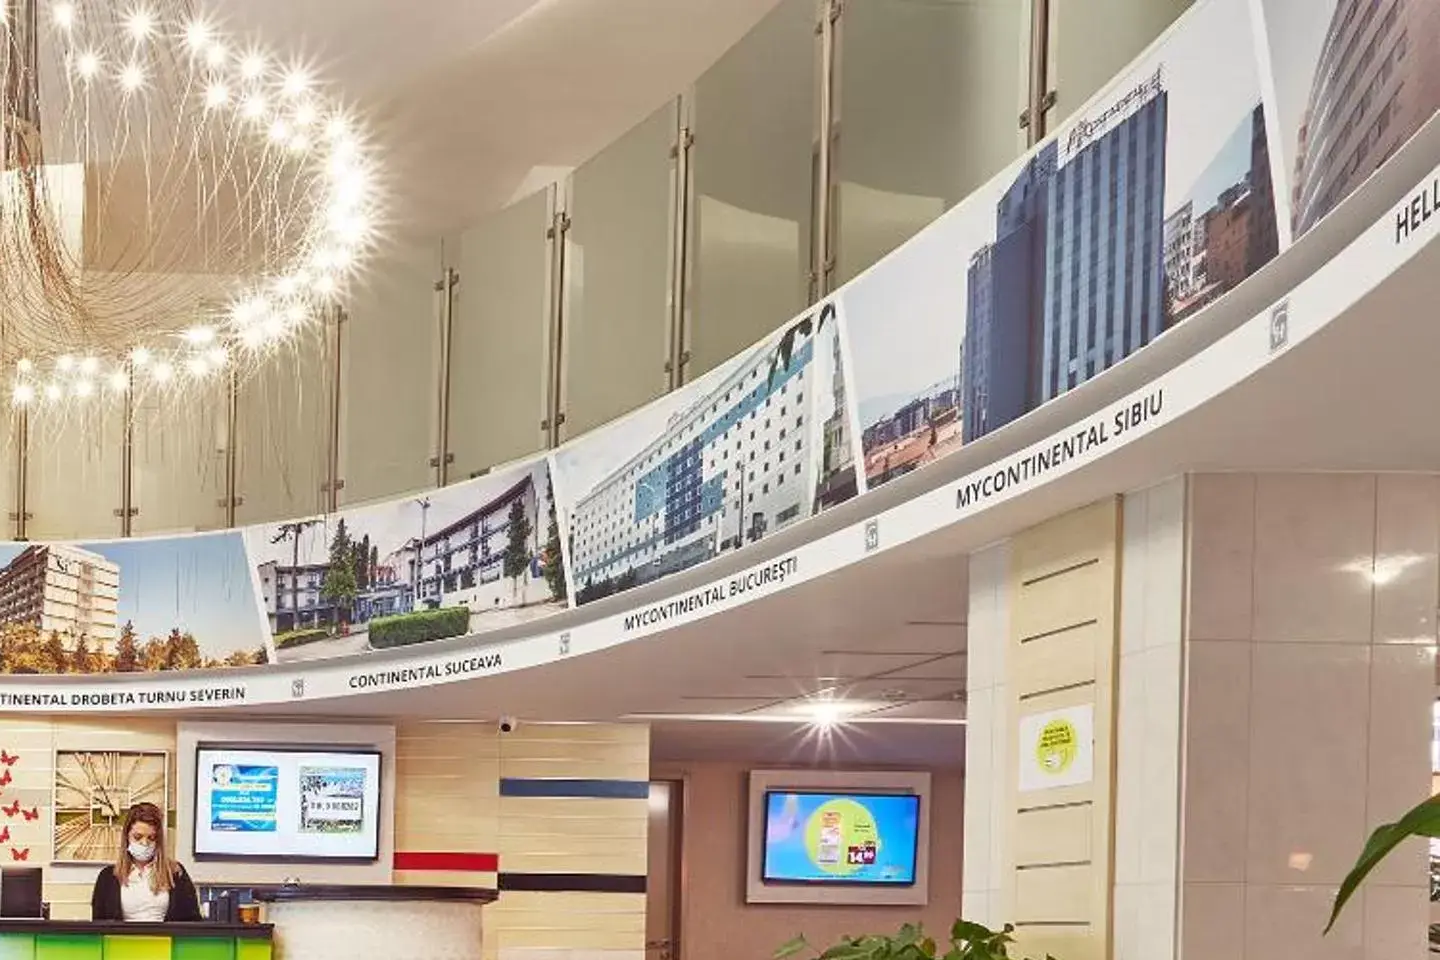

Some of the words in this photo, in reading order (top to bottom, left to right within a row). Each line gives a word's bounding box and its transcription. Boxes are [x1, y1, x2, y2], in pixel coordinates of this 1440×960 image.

[1396, 178, 1440, 244] HELL
[956, 422, 1109, 510] MYCONTINENTAL
[1113, 389, 1164, 437] SIBIU
[623, 585, 727, 632] MYCONTINENTAL
[348, 664, 442, 689] CONTINENTAL
[445, 653, 502, 676] SUCEAVA
[71, 691, 135, 706] DROBETA
[138, 691, 185, 704] TURNU
[189, 687, 246, 702] SEVERIN
